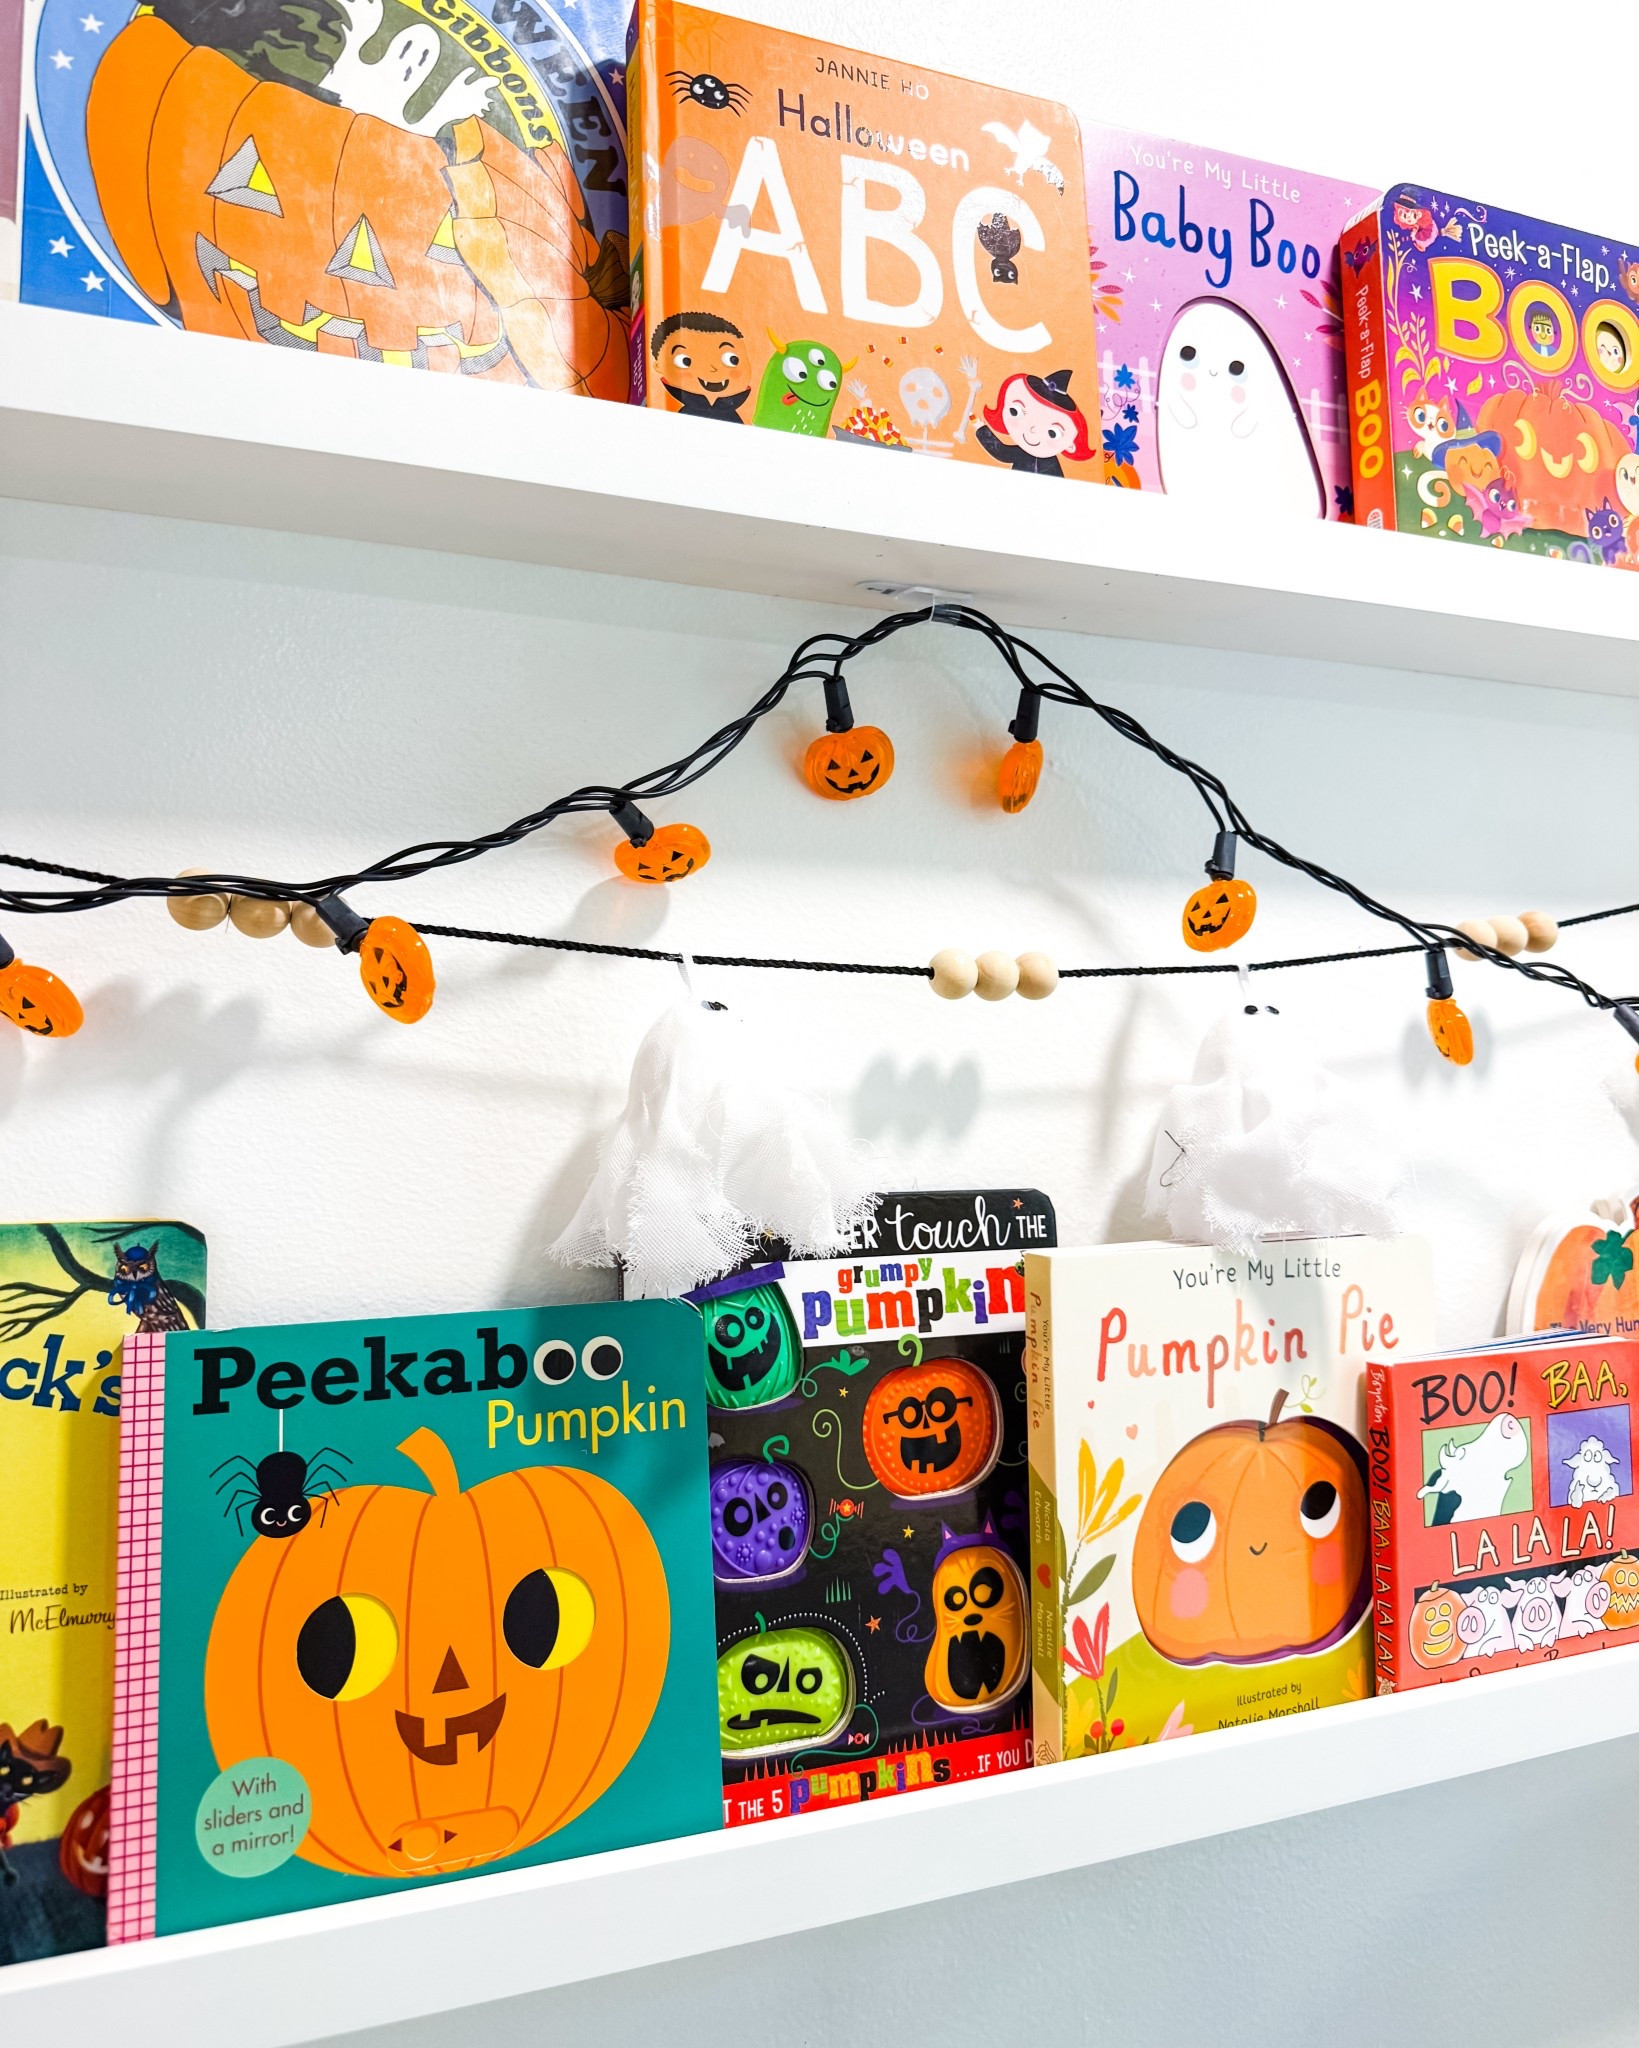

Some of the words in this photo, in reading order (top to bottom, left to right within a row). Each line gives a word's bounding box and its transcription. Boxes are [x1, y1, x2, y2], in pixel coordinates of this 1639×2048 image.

[421, 0, 553, 142] Gibbons
[815, 57, 890, 90] JANNIE
[901, 79, 929, 100] HO
[778, 88, 969, 172] Halloween
[1130, 145, 1194, 175] You're
[1205, 160, 1231, 190] My
[1241, 170, 1301, 203] Little
[701, 136, 1053, 354] ABC
[1114, 170, 1232, 288] Baby
[1249, 198, 1321, 279] Boo
[1467, 223, 1610, 293] Peek-a-Flap
[1355, 284, 1375, 379] Peek-a-Flap
[1427, 256, 1639, 394] BOO
[1355, 379, 1384, 479] BOO
[884, 1195, 1012, 1251] touch
[1015, 1215, 1048, 1239] THE
[802, 1266, 1025, 1339] pumpkin
[838, 1257, 933, 1293] grumpy
[1173, 1262, 1237, 1290] You're
[1248, 1260, 1274, 1286] My
[1284, 1257, 1341, 1279] Little
[1026, 1291, 1043, 1384] Pumpkin
[1042, 1356, 1050, 1372] My
[1097, 1298, 1307, 1408] Pumpkin
[1339, 1284, 1399, 1354] Pie
[193, 1327, 624, 1416] Peekaboo
[1043, 1376, 1051, 1410] Little
[1411, 1361, 1518, 1425] BOO!
[1541, 1360, 1629, 1408] BAA,
[488, 1380, 686, 1454] Pumpkin
[1369, 1425, 1392, 1494] BOO!
[1034, 1490, 1042, 1545] Edwards
[1043, 1500, 1051, 1541] Nicola
[1373, 1499, 1392, 1557] BAA,
[1450, 1529, 1500, 1576] LA
[1511, 1516, 1551, 1565] LA
[1561, 1504, 1616, 1557] LA!
[0, 1584, 68, 1600] Illustrated
[73, 1583, 88, 1596] by
[1375, 1563, 1392, 1594] LA
[1036, 1600, 1045, 1657] Marshall
[1045, 1609, 1053, 1658] Natalie
[1376, 1599, 1394, 1626] LA
[1377, 1630, 1396, 1676] LA!
[1236, 1684, 1288, 1707] Illustrated
[1290, 1682, 1302, 1695] by
[204, 1805, 262, 1831] sliders
[269, 1793, 304, 1819] and
[232, 1772, 277, 1797] With
[738, 1797, 765, 1821] THE
[772, 1789, 784, 1814] 5
[788, 1750, 950, 1815] pumpkins
[997, 1748, 1020, 1769] YOU
[212, 1843, 224, 1856] a
[232, 1824, 294, 1853] mirror!
